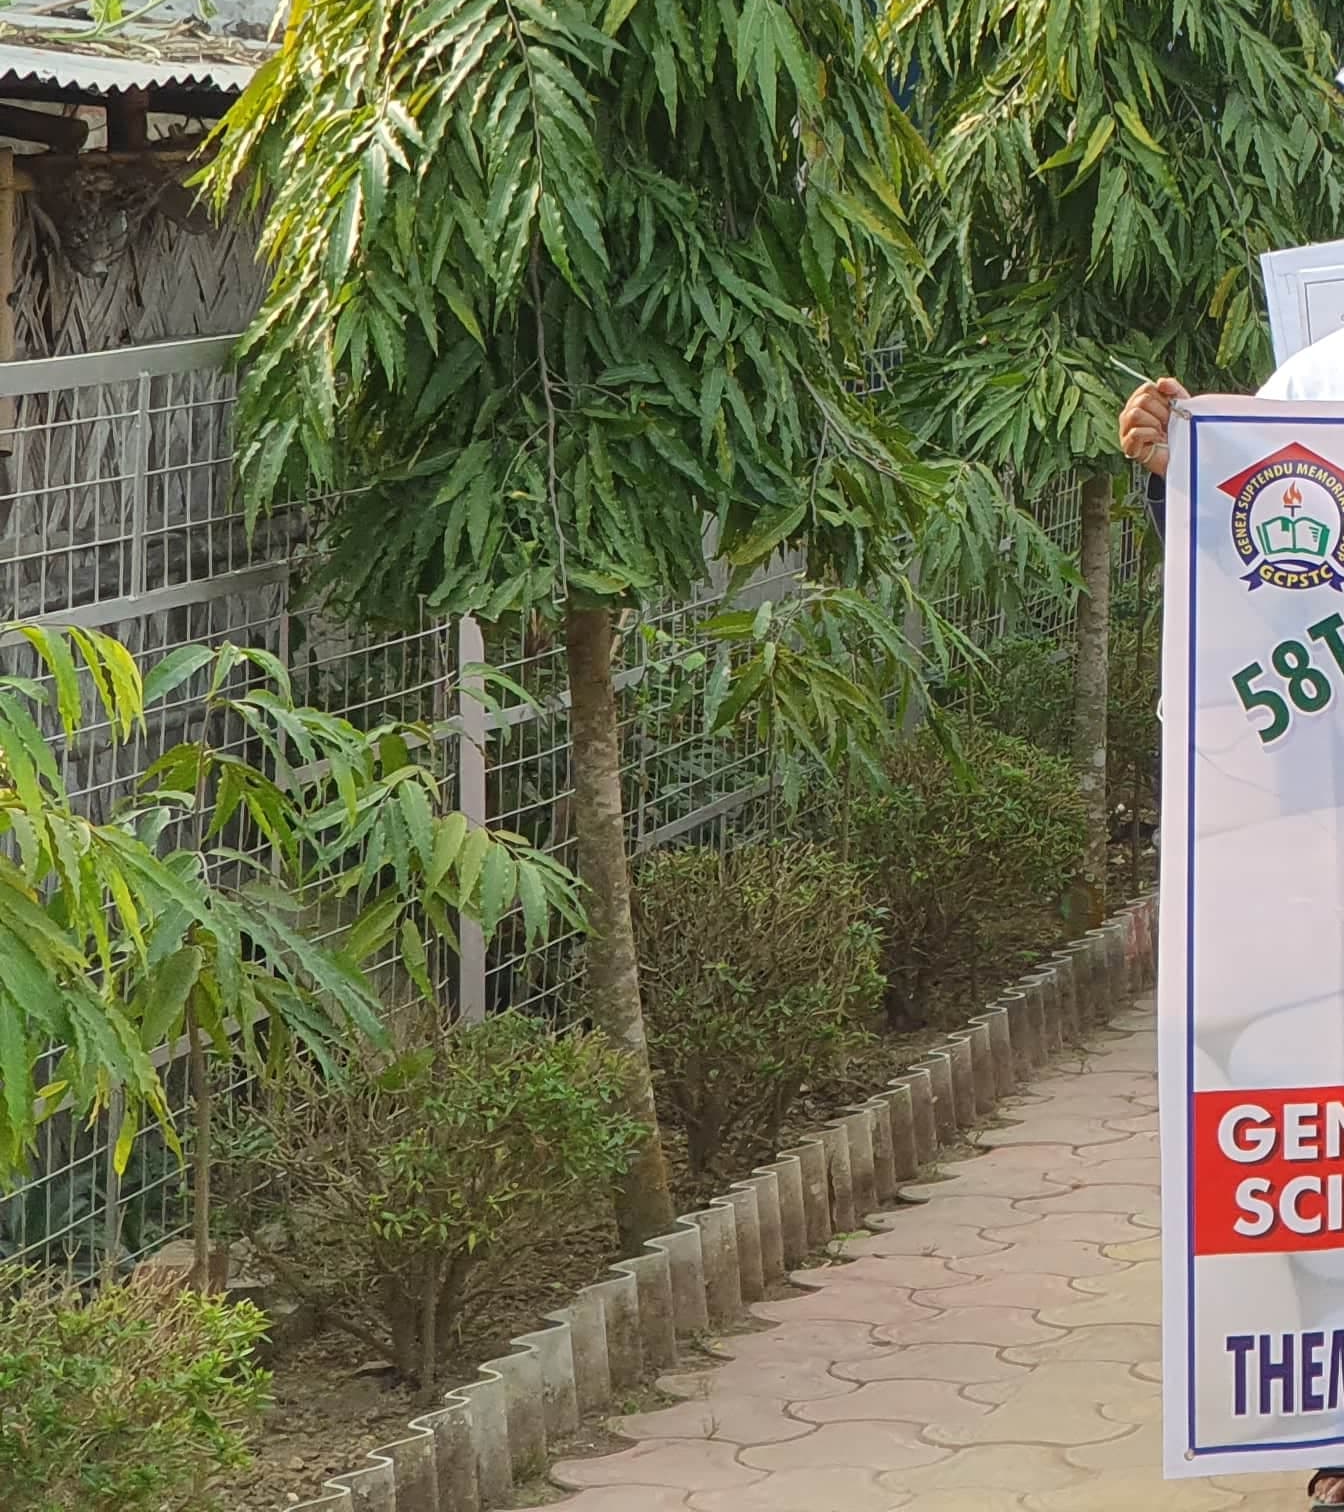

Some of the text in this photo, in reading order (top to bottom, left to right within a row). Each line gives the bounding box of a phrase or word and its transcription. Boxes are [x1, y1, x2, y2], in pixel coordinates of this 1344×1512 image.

[1238, 461, 1294, 510] SUPTENDU
[1235, 511, 1254, 556] GENEX
[1259, 564, 1334, 588] GCPSTC
